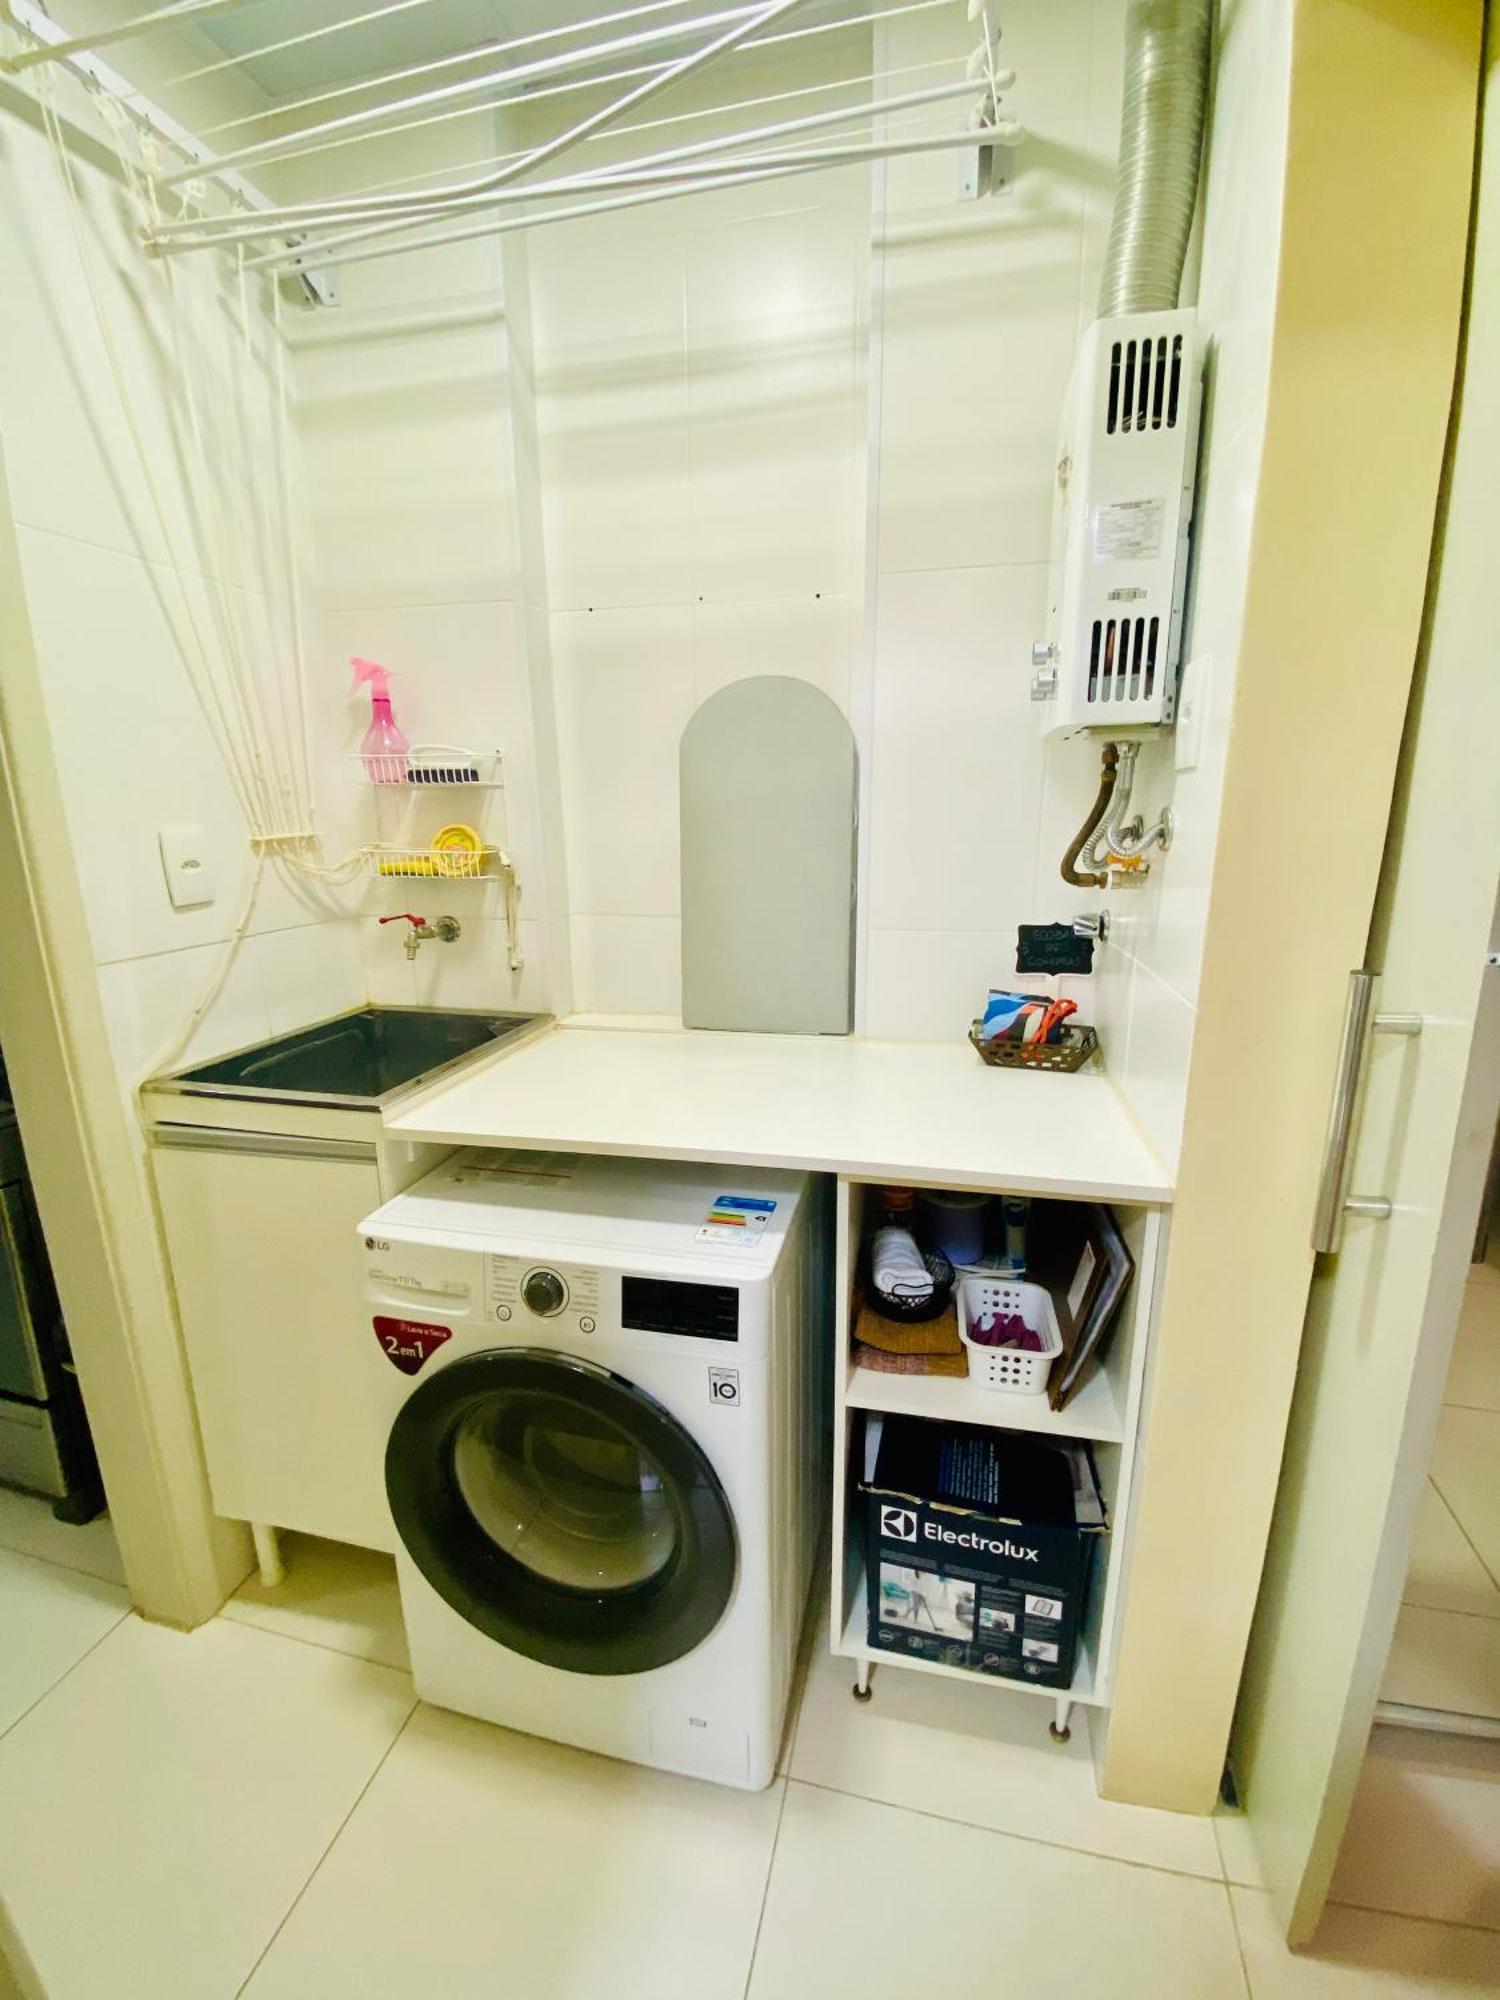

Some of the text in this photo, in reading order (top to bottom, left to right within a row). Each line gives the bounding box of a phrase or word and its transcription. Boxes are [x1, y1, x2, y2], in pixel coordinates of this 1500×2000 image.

[385, 1335, 424, 1359] 2 em 1
[924, 1522, 1039, 1562] Electrolux
